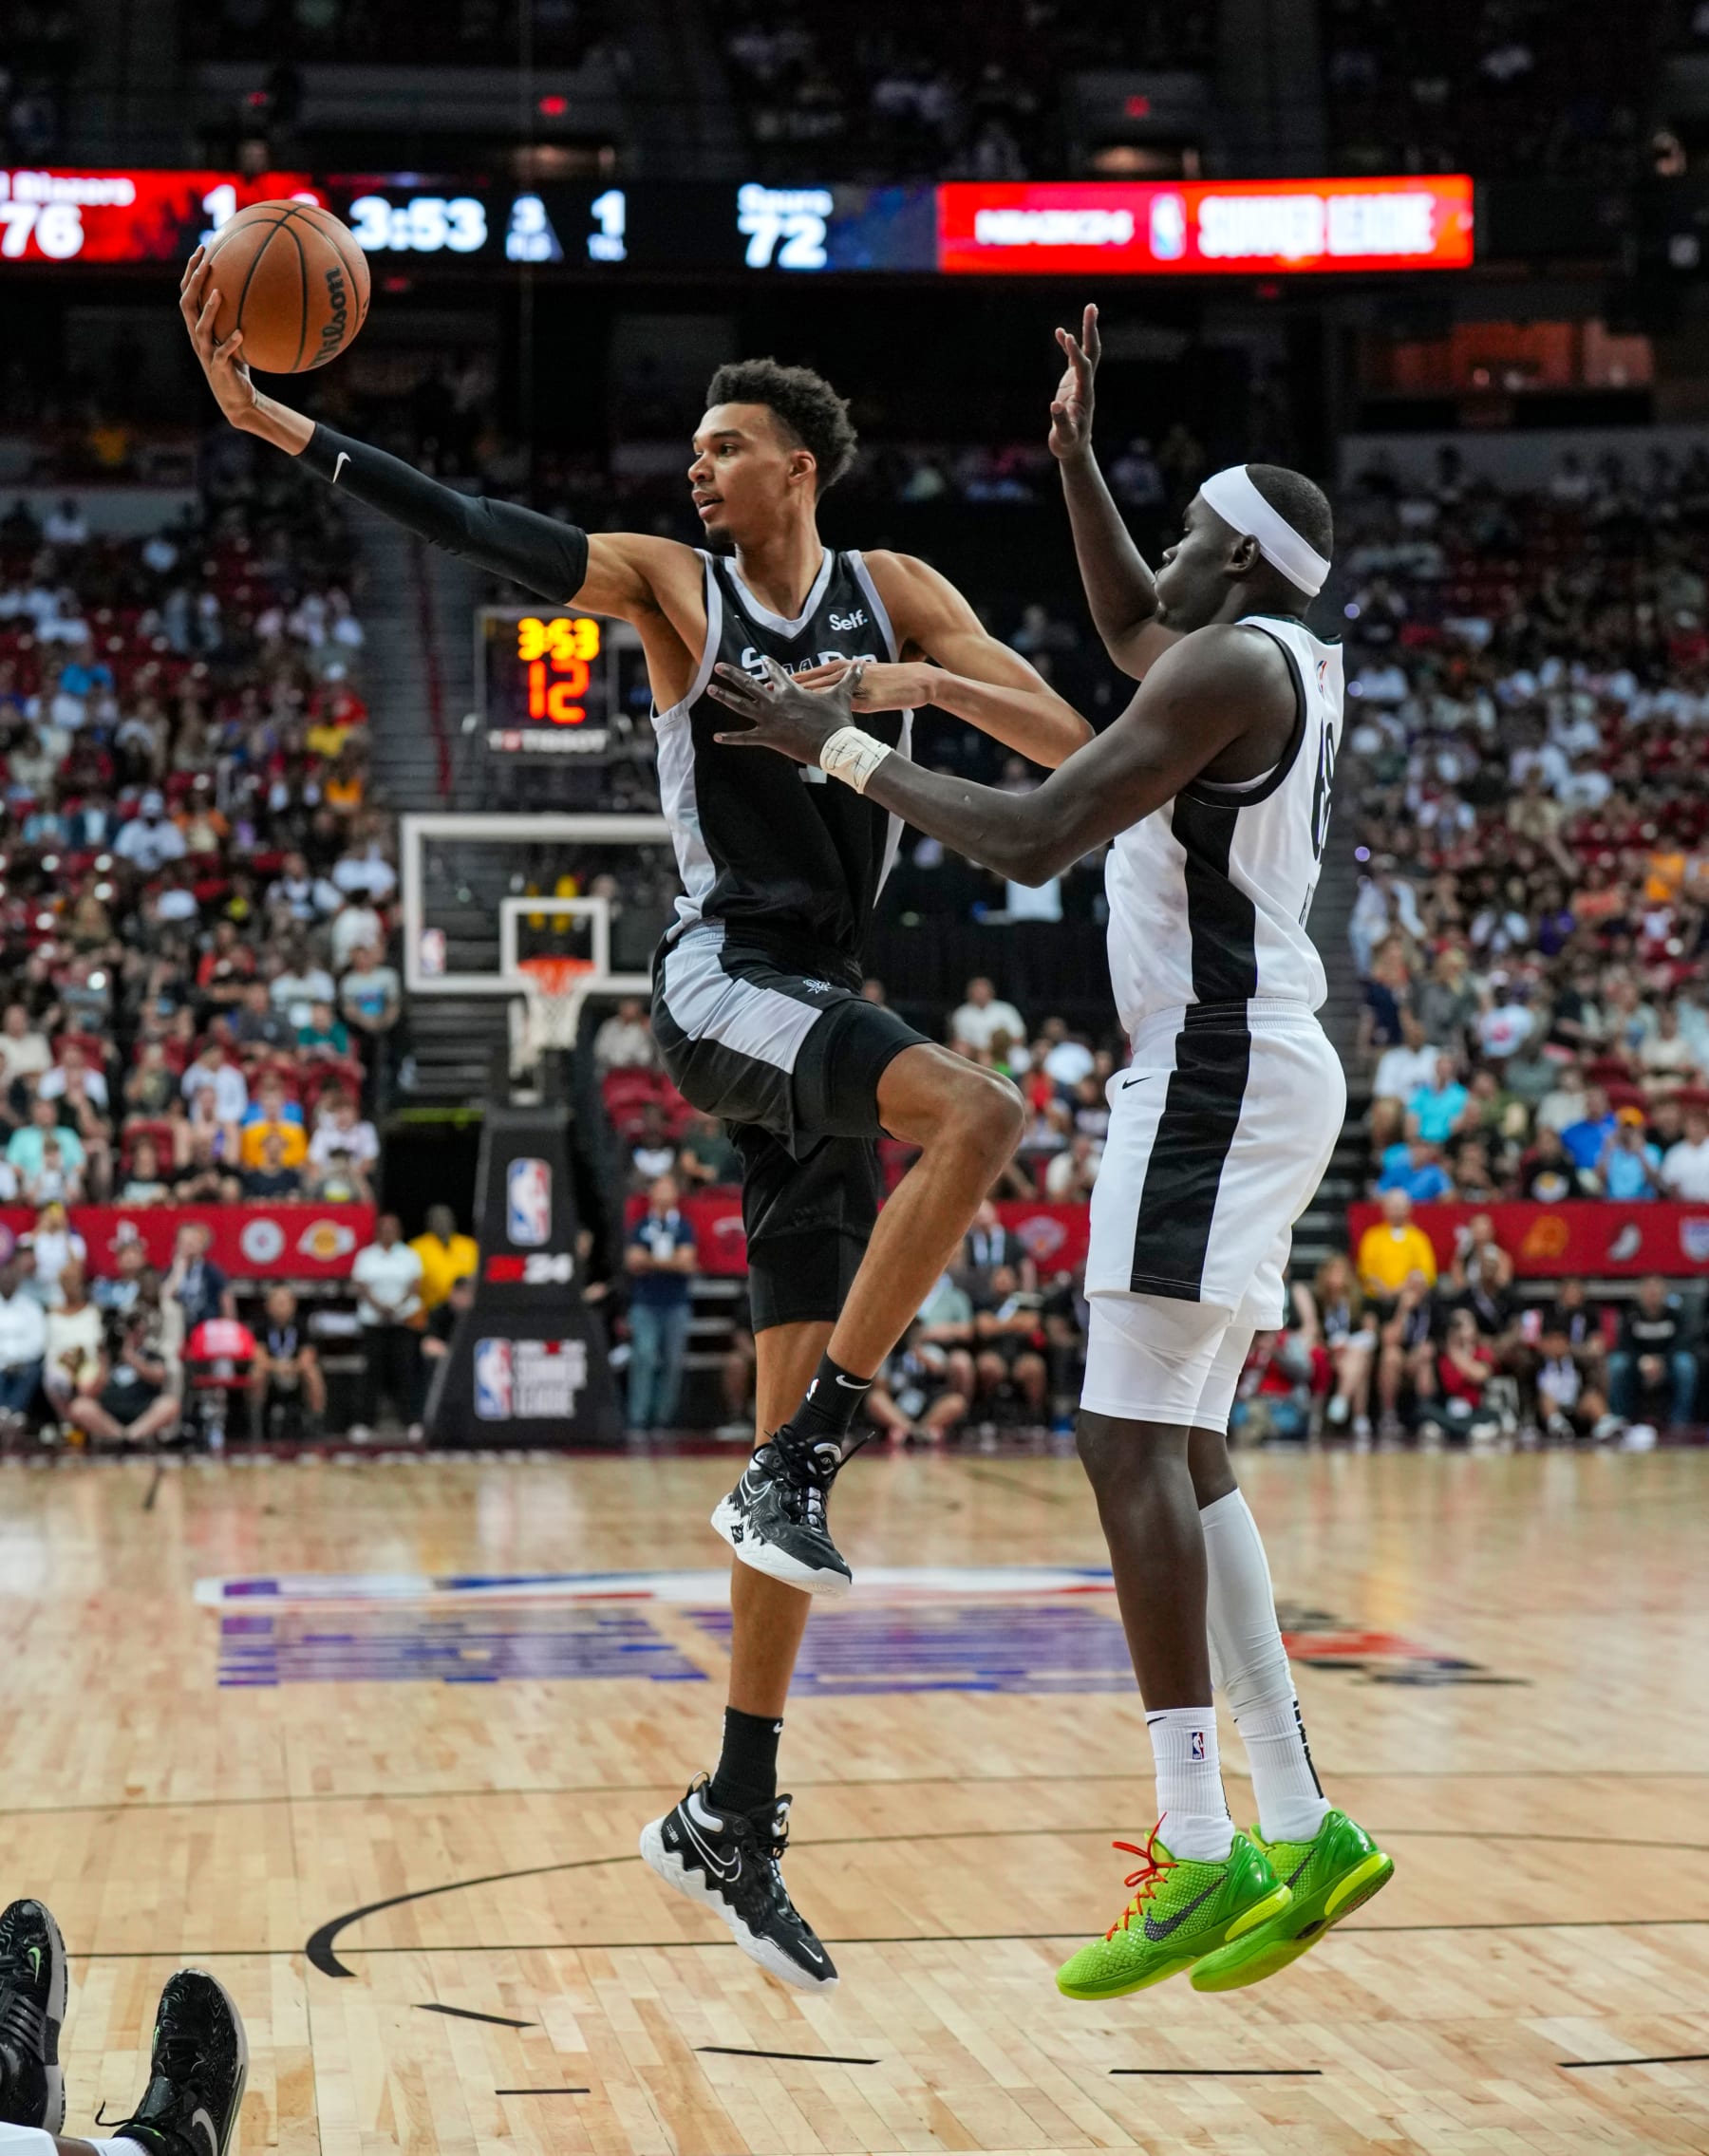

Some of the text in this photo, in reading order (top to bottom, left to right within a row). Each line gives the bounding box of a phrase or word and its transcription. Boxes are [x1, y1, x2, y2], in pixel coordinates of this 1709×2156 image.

[0, 204, 85, 258] 76
[348, 196, 487, 253] 3:53
[591, 190, 626, 234] 1
[738, 213, 828, 268] 72
[308, 267, 347, 366] Wilson
[529, 657, 591, 724] 12
